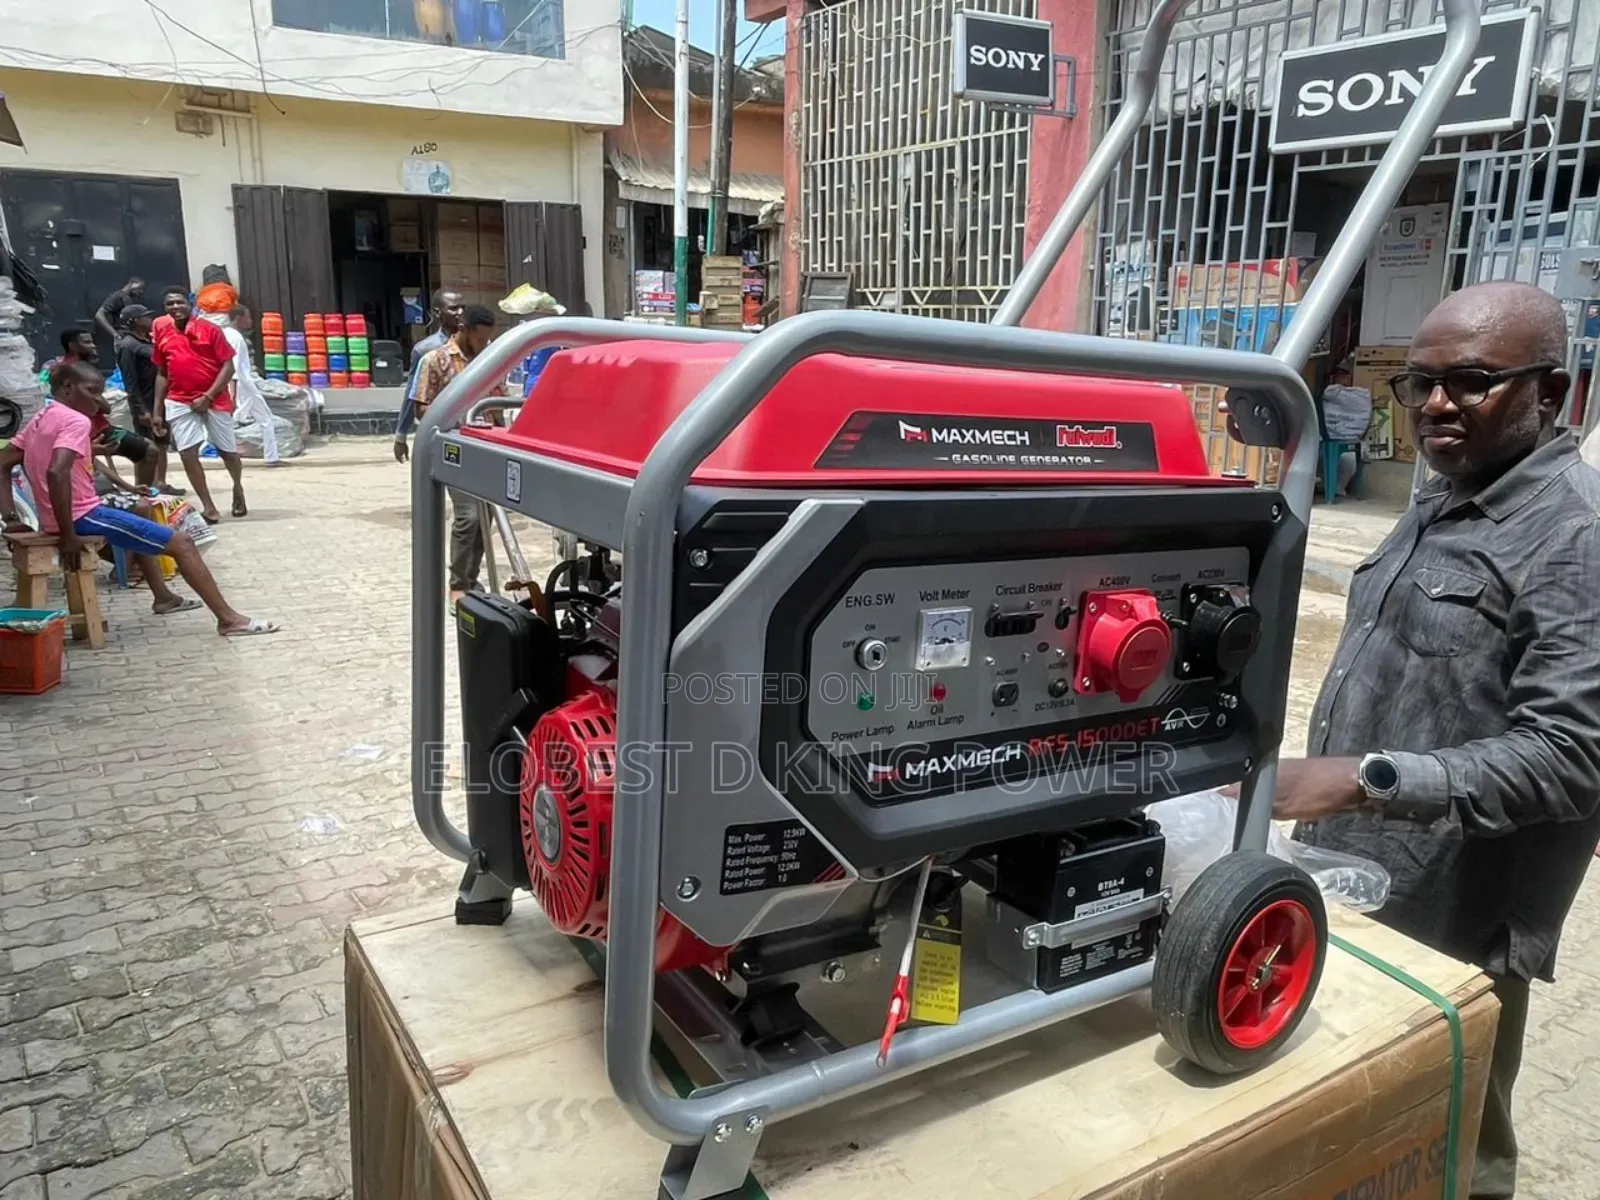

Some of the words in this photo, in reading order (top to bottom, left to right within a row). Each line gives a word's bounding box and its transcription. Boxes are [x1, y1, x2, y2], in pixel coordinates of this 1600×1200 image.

[970, 45, 1045, 71] SONY
[931, 428, 1030, 446] MAXMECH
[952, 454, 1016, 465] GASOLINE
[1020, 455, 1091, 466] GENERATOR
[919, 590, 939, 601] Volt
[941, 589, 970, 600] Meter
[996, 584, 1025, 596] Circuit
[1028, 582, 1063, 593] Breaker
[845, 593, 895, 608] ENG.SW
[930, 704, 944, 716] Oil
[906, 718, 936, 730] Alarm
[938, 713, 965, 726] Lamp
[1164, 721, 1184, 731] AVR
[831, 728, 864, 742] Power
[866, 724, 895, 738] Lamp
[905, 744, 1021, 780] MAXMECH
[724, 869, 744, 879] Rated
[723, 881, 744, 890] Power
